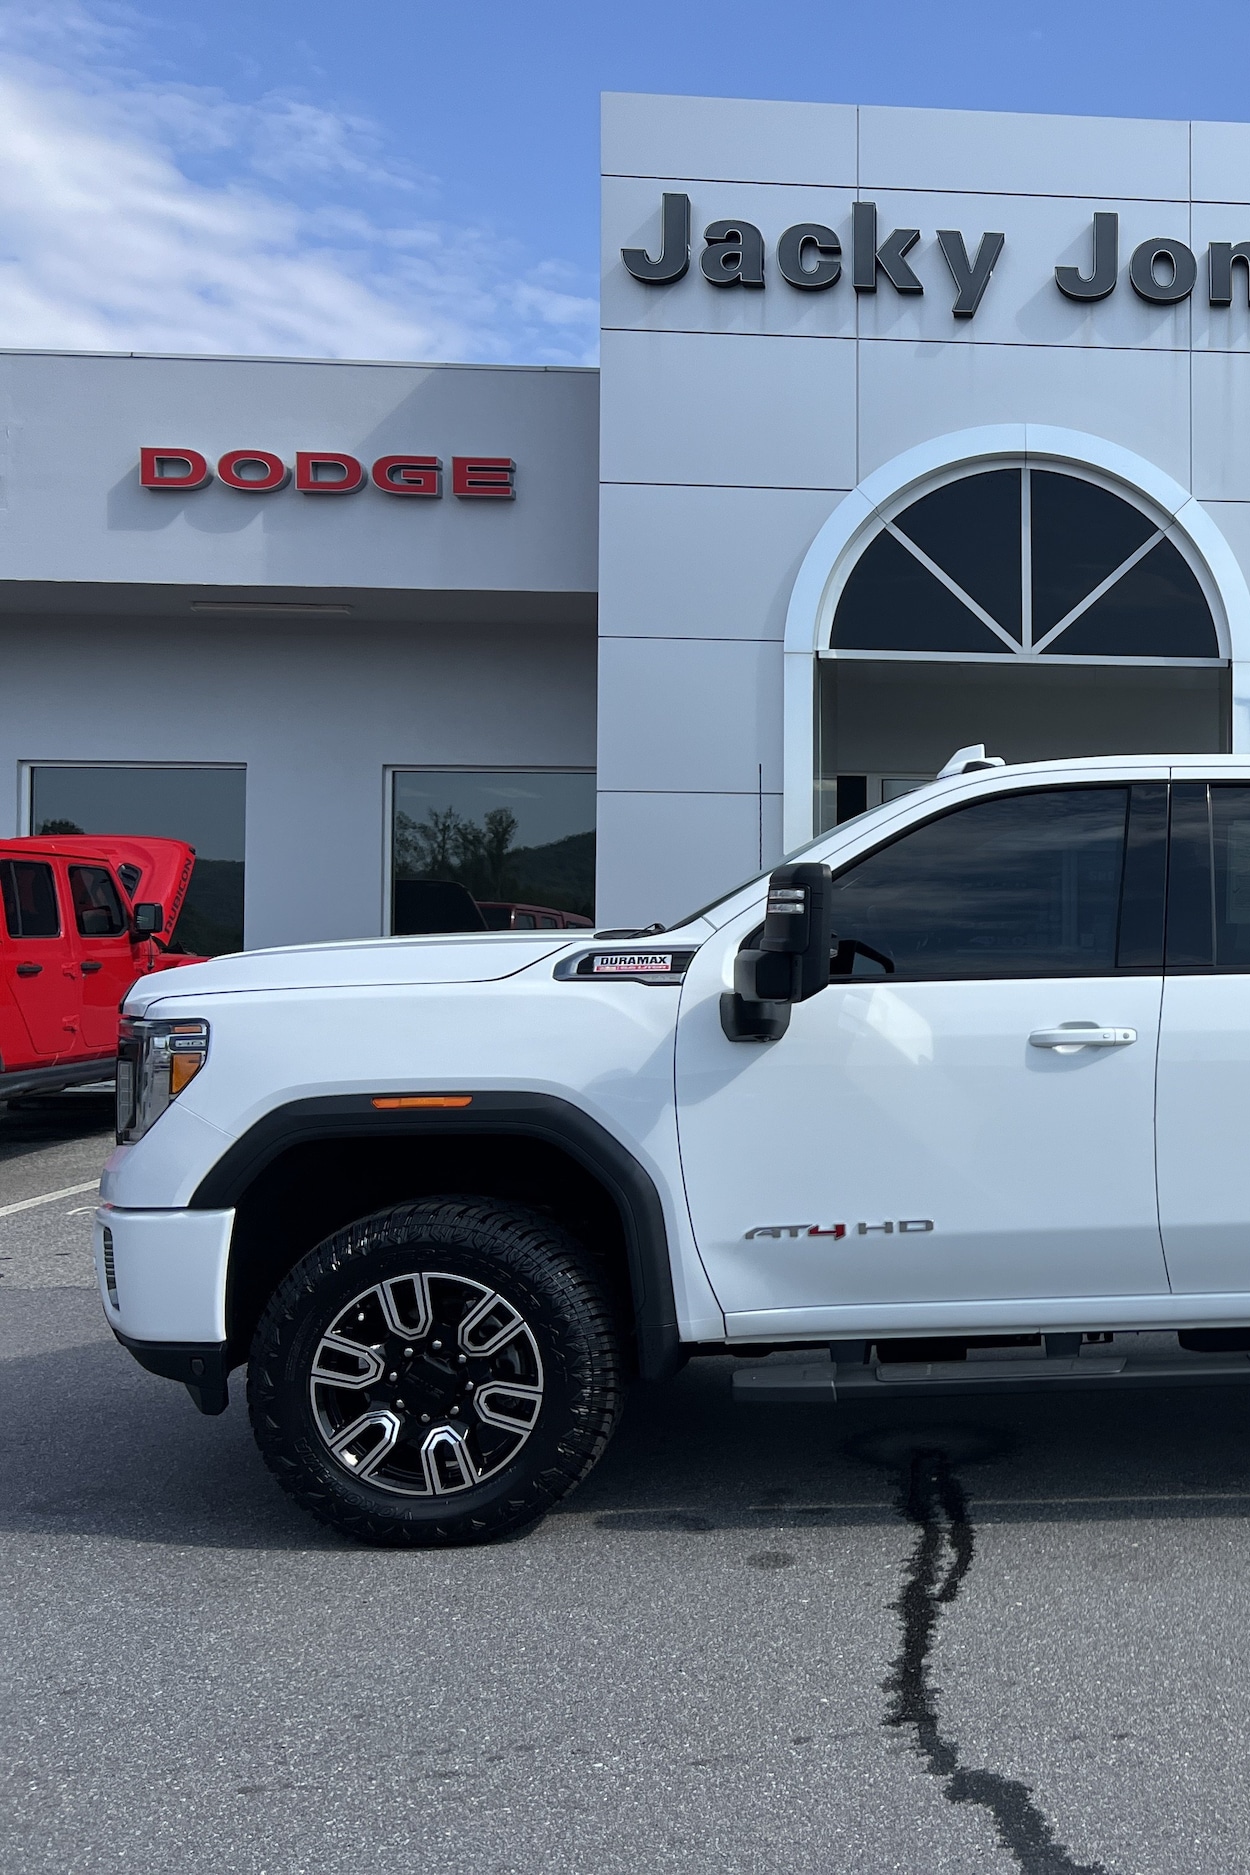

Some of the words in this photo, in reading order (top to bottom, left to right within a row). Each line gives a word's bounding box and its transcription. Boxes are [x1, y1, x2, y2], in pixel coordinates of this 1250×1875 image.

[620, 192, 1005, 318] Jacky
[139, 446, 517, 500] DODGE
[165, 857, 193, 935] RUBICON
[600, 956, 668, 965] DURAMAX
[745, 1223, 846, 1241] AT4
[858, 1219, 935, 1235] HD
